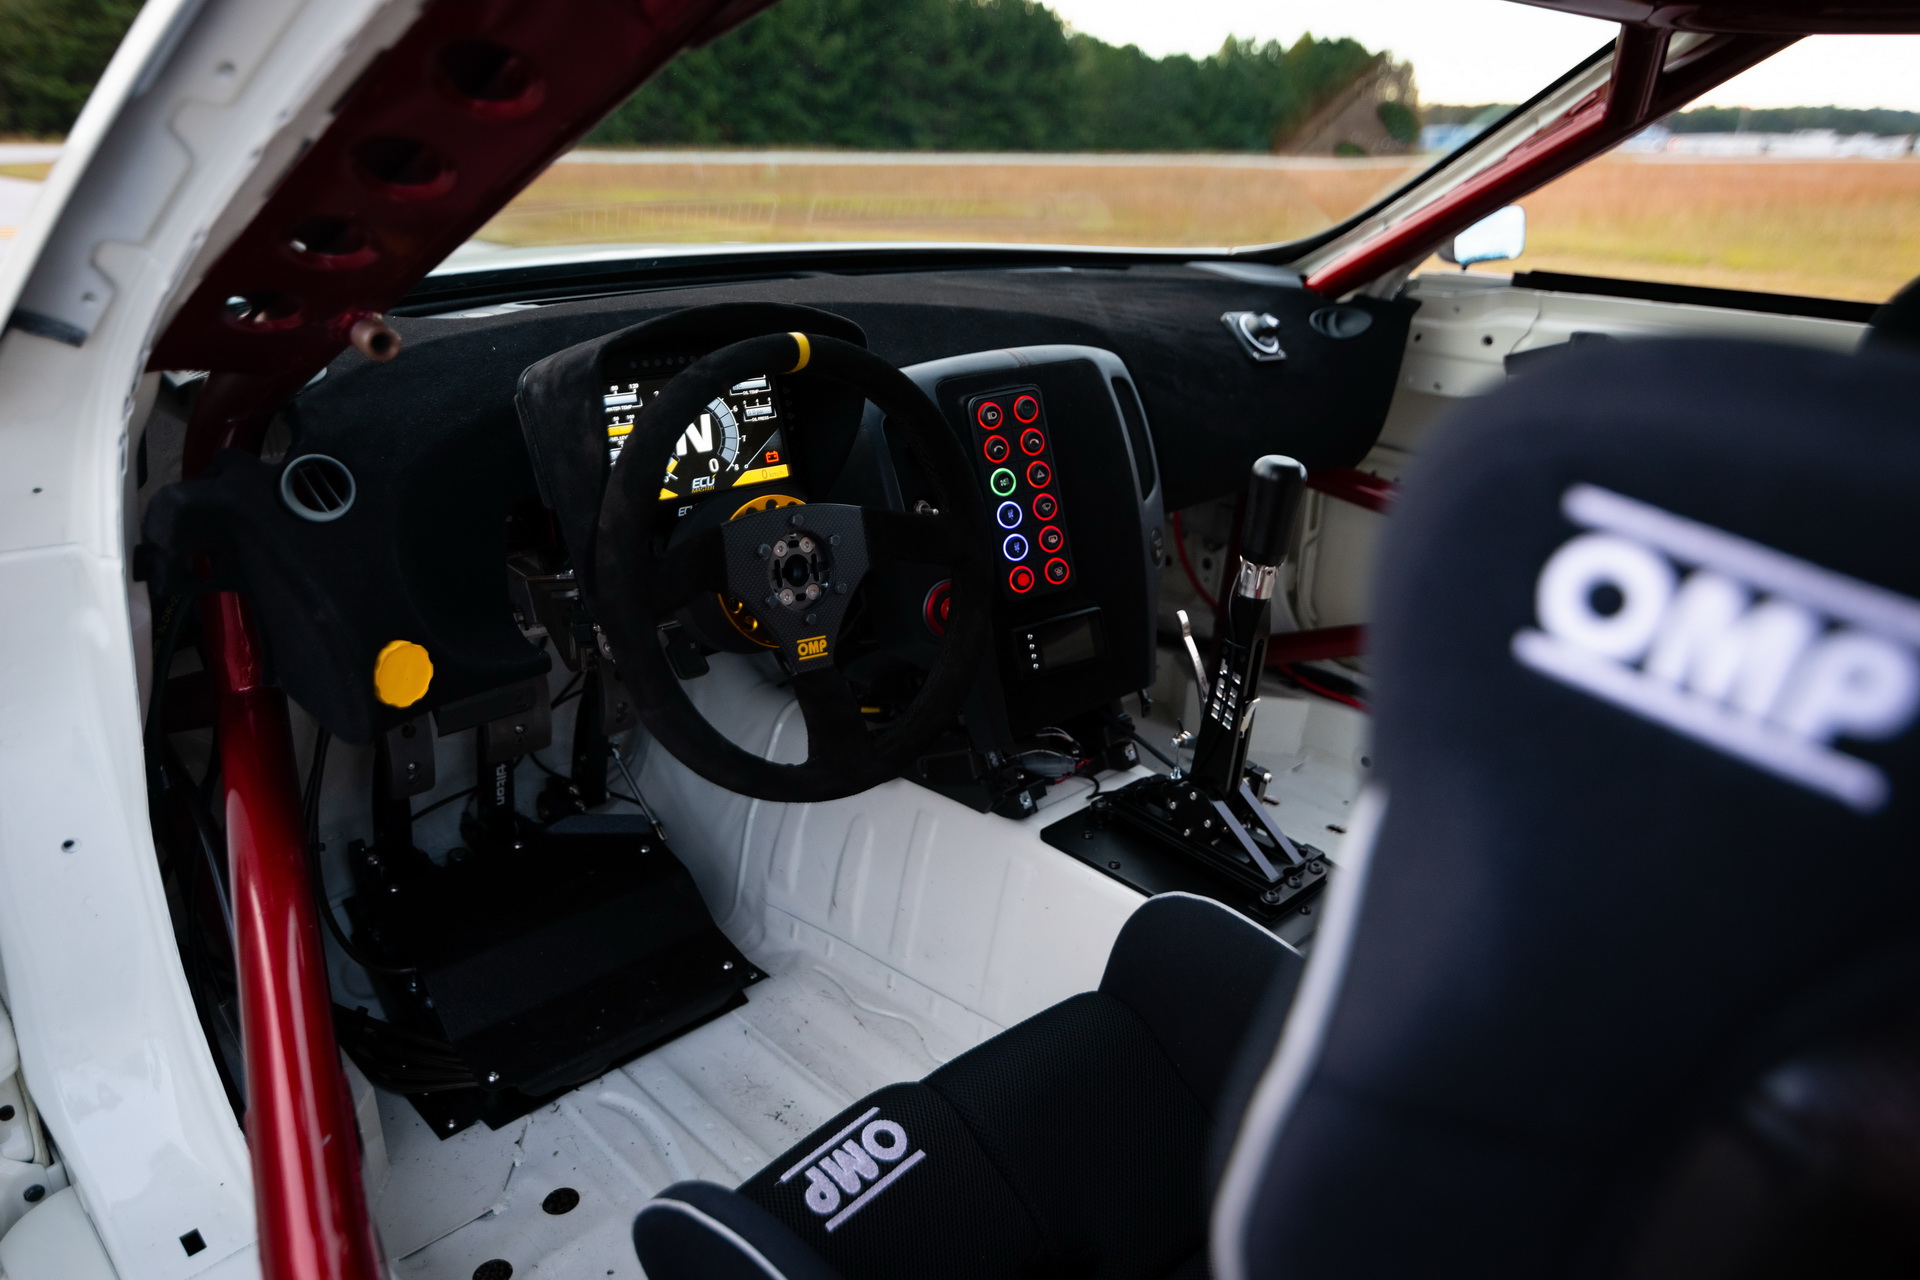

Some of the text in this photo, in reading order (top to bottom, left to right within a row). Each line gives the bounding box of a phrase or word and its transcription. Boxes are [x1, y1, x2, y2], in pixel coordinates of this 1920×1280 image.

[741, 435, 747, 443] 7
[709, 458, 719, 472] 0
[761, 469, 768, 479] 0
[692, 475, 716, 488] ECU
[691, 485, 715, 494] MASTER
[1535, 531, 1920, 742] OMP
[797, 638, 828, 657] OMP
[805, 1119, 908, 1215] OMP
